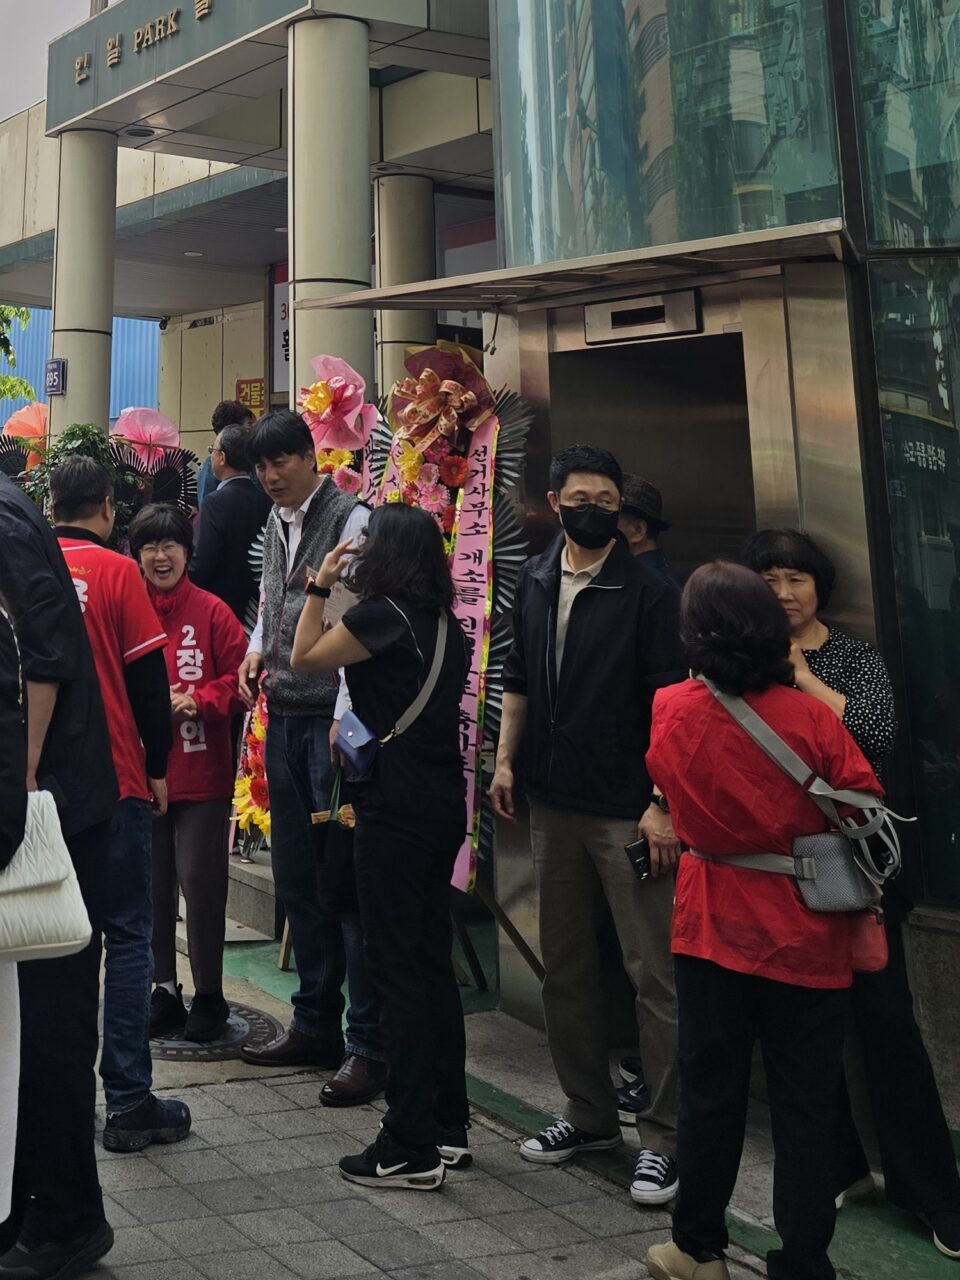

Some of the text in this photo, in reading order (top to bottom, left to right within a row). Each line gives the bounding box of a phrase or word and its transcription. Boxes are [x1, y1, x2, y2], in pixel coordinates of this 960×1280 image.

[133, 7, 182, 53] PARK
[240, 382, 264, 405] 건물
[460, 445, 490, 537] 선거사무소
